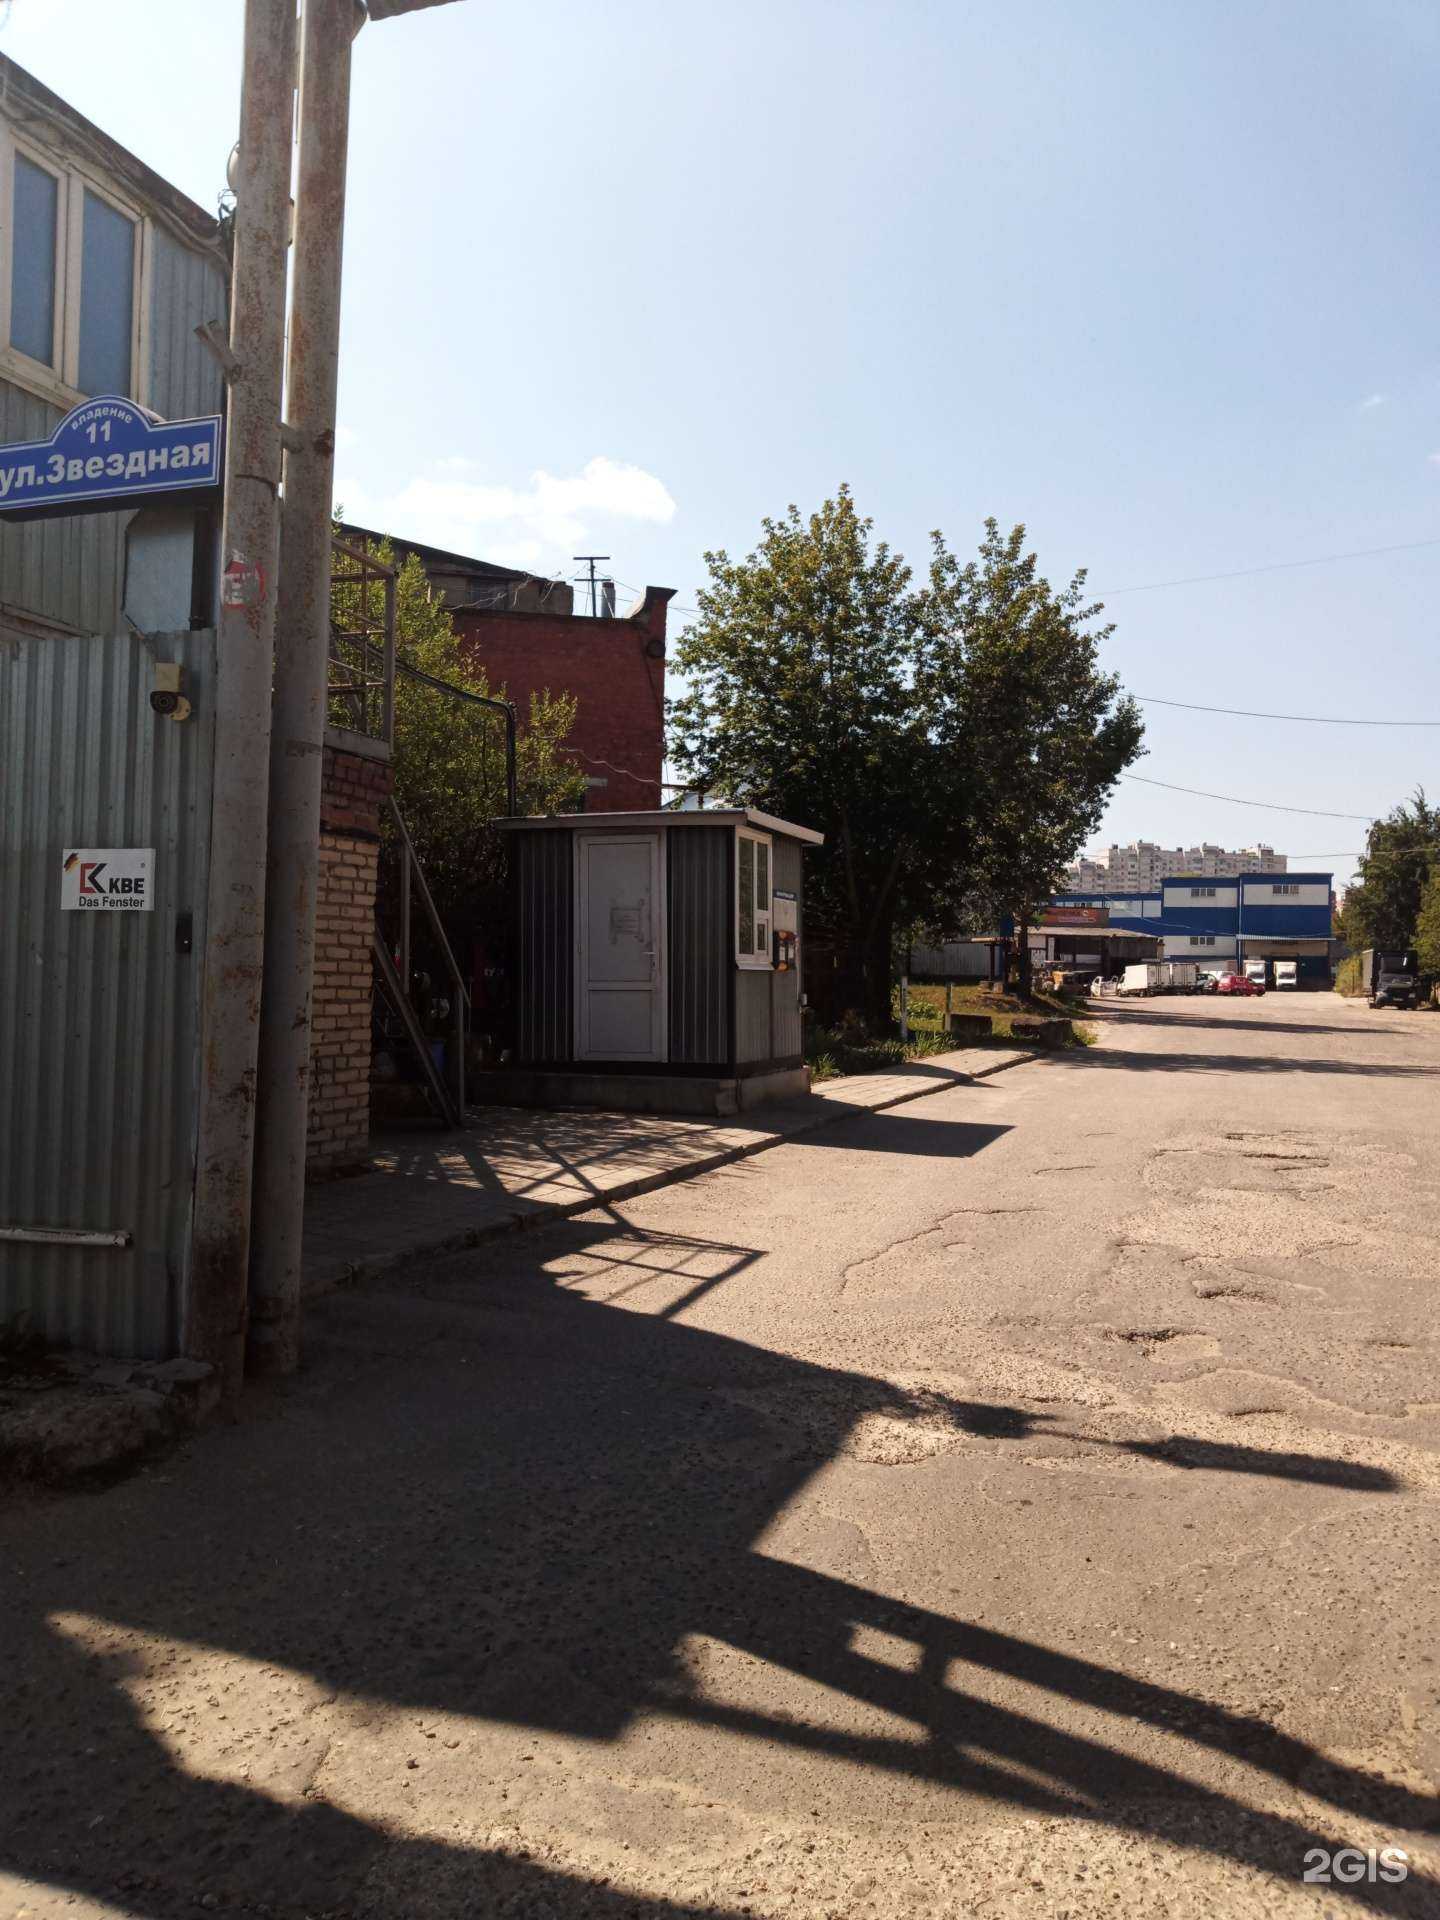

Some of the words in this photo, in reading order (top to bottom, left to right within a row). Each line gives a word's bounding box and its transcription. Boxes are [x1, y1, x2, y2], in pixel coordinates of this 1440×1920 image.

[86, 420, 111, 444] 11
[0, 442, 210, 497] ул.Звездная
[109, 878, 145, 894] KBE
[79, 896, 99, 907] Das
[102, 896, 145, 908] Fenster
